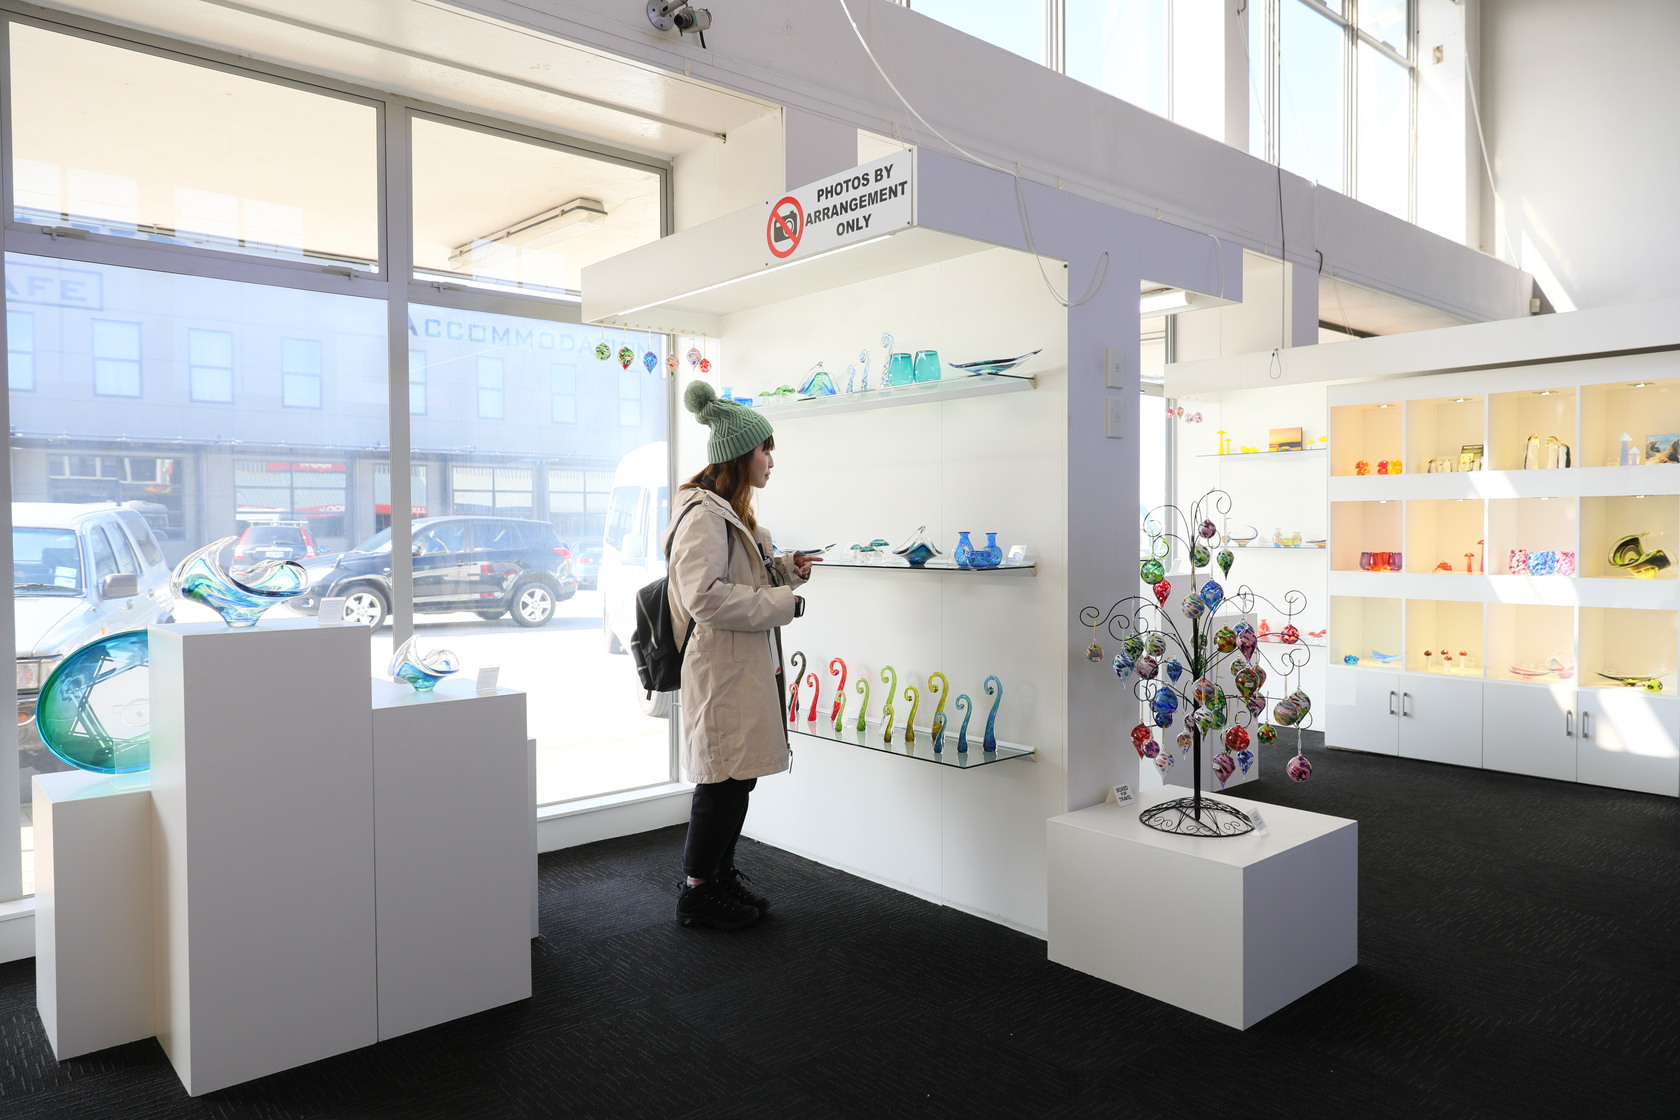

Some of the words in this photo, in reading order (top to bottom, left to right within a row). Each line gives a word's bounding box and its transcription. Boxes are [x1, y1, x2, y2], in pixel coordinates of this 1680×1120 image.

[817, 173, 870, 203] PHOTOS
[874, 163, 894, 183] BY
[805, 180, 908, 227] ARRANGEMENT
[836, 213, 873, 237] ONLY
